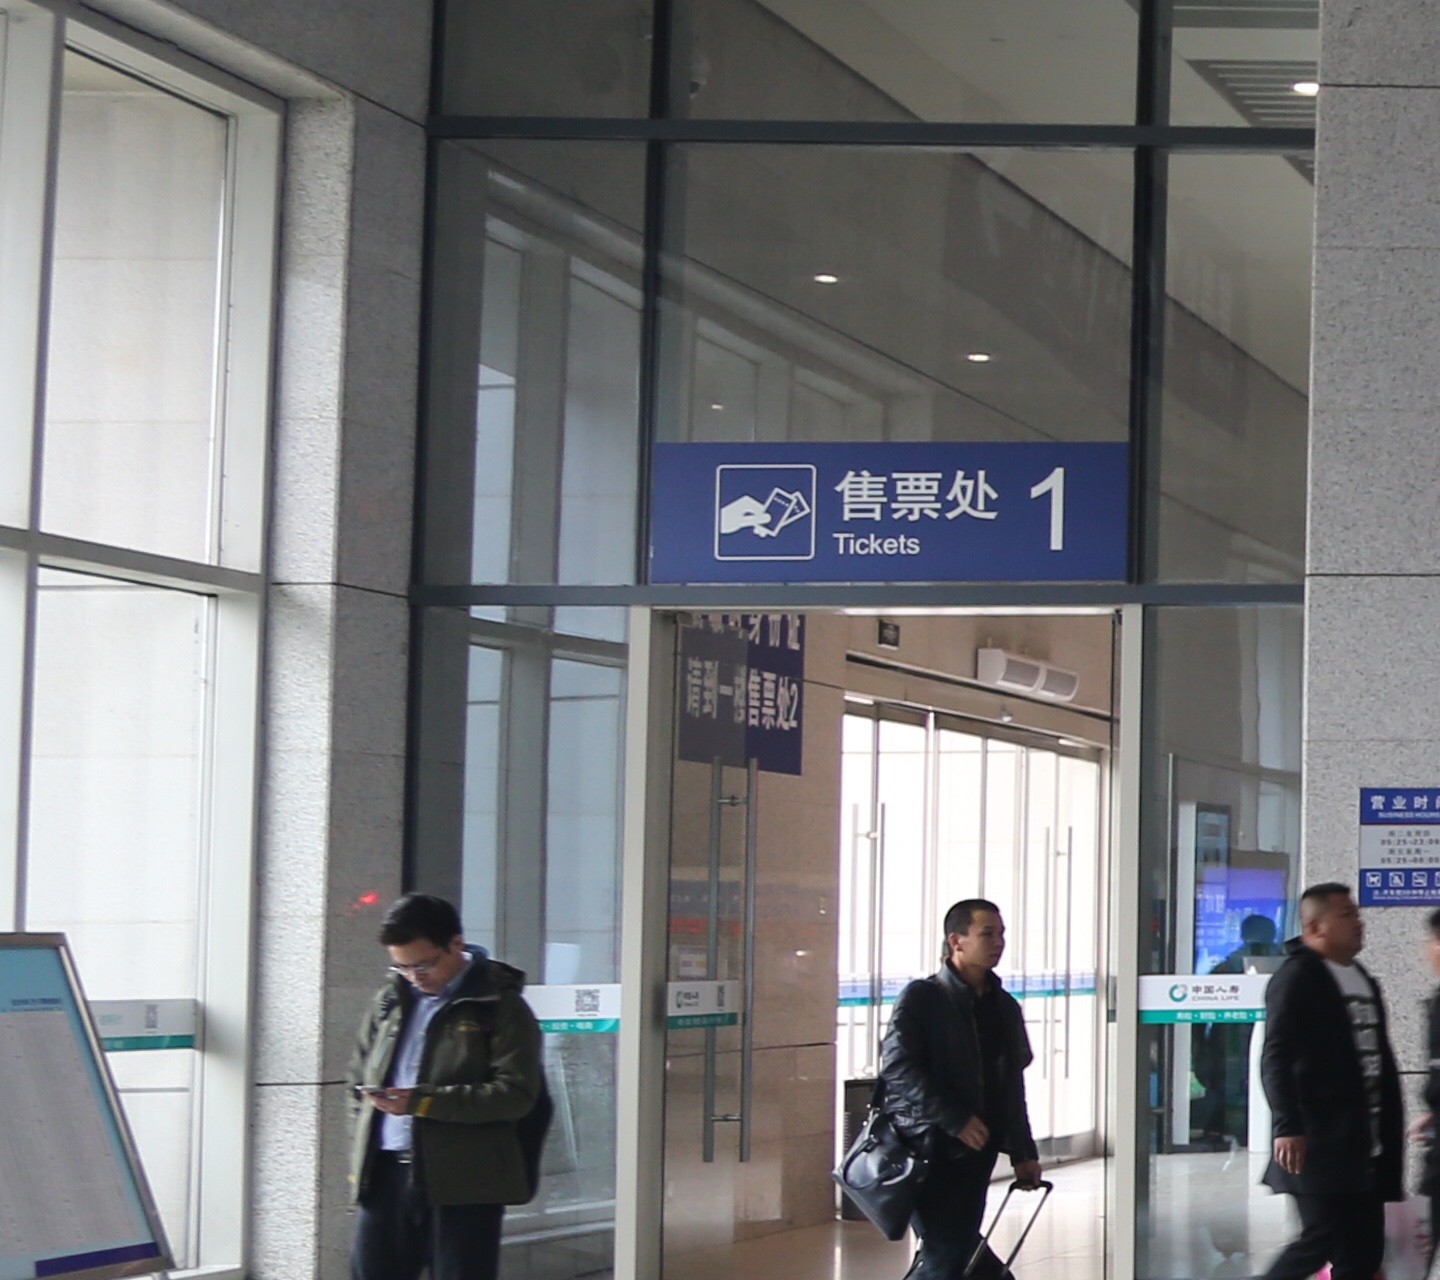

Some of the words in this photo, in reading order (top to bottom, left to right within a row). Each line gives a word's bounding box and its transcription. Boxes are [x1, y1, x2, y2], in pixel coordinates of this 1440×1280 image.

[835, 469, 999, 522] 售票处
[1030, 467, 1066, 551] 1
[833, 532, 920, 556] Tickets
[1191, 985, 1239, 994] 中国人寿
